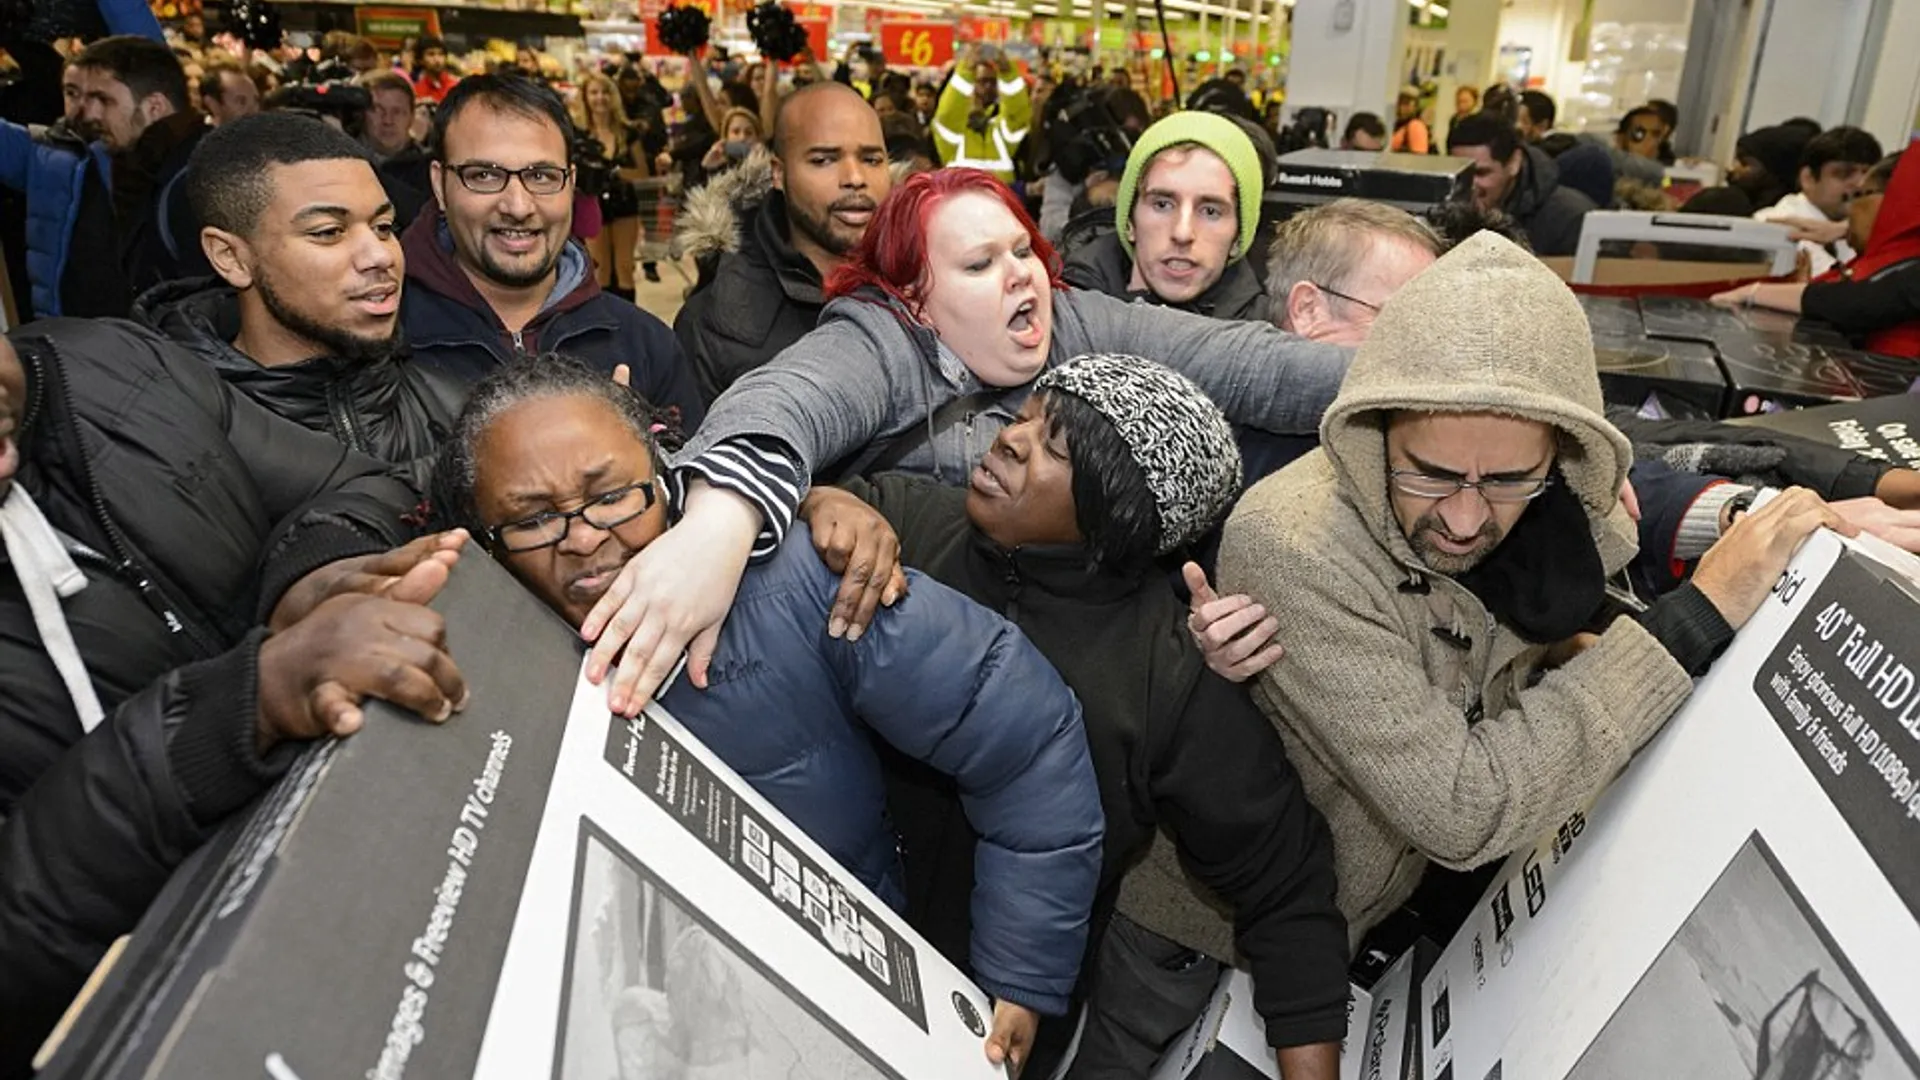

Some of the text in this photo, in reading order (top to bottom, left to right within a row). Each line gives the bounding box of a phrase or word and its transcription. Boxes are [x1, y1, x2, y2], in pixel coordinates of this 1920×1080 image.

[900, 30, 933, 66] £6
[1279, 172, 1343, 188] Russell Hobbs
[1787, 644, 1814, 683] Enjoy
[1814, 600, 1853, 643] 40"
[1836, 622, 1876, 681] Full
[1867, 653, 1915, 710] HD
[1807, 671, 1845, 719] glorious
[1770, 672, 1849, 776] with family & friends
[1838, 705, 1864, 738] Full
[1859, 722, 1880, 756] HD
[1869, 742, 1920, 804] (1080p)
[364, 729, 513, 1080] mages & Freeview HD TV channels
[1523, 848, 1546, 918] LED
